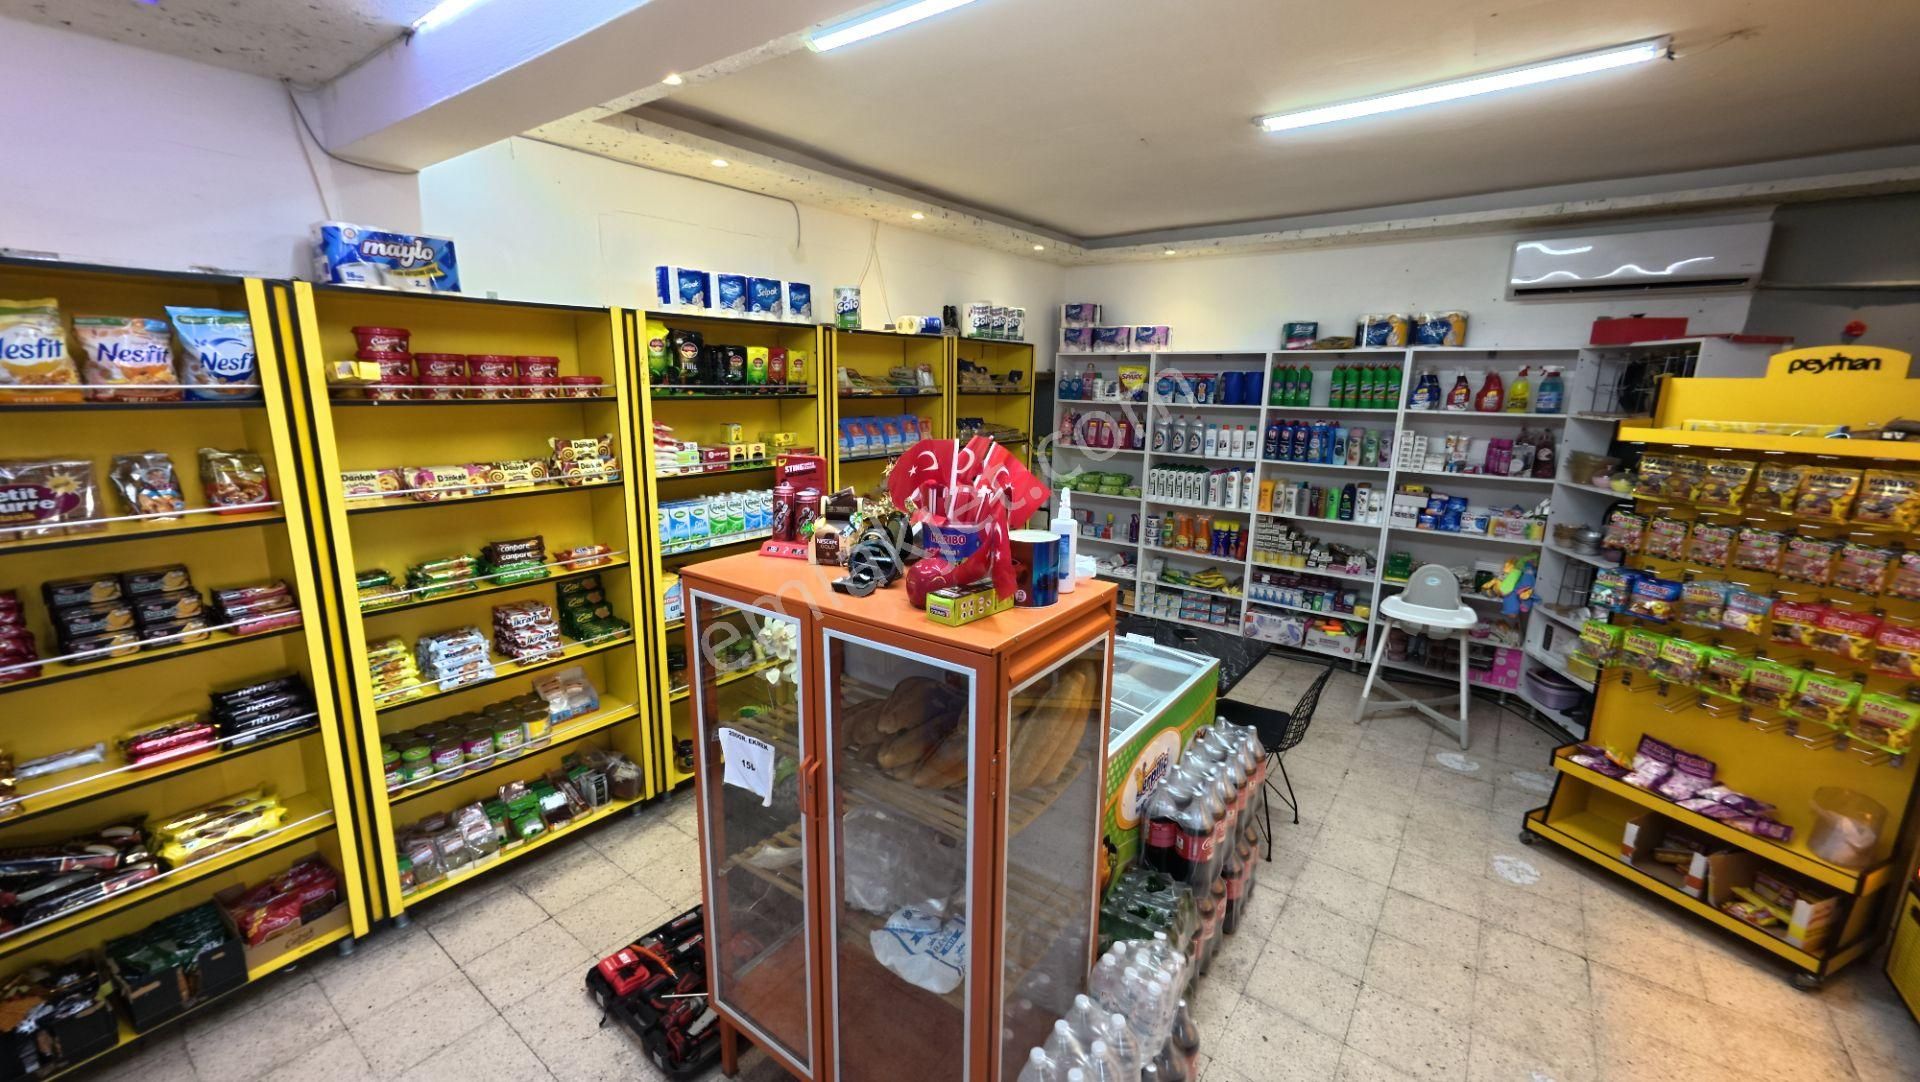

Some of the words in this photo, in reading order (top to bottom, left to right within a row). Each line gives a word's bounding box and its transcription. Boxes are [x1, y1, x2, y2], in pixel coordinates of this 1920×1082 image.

[362, 239, 434, 268] maylo
[757, 285, 778, 297] Selpak
[837, 299, 859, 314] Solo
[974, 315, 992, 327] Solo
[992, 316, 1006, 327] olo
[1008, 318, 1020, 328] olo
[97, 342, 170, 363] Nesfit
[201, 351, 254, 371] Nesfi
[1788, 353, 1881, 374] peyman
[0, 487, 39, 502] etit
[0, 499, 56, 513] urre
[931, 532, 967, 545] HARIBO
[1664, 643, 1697, 660] HARIBO
